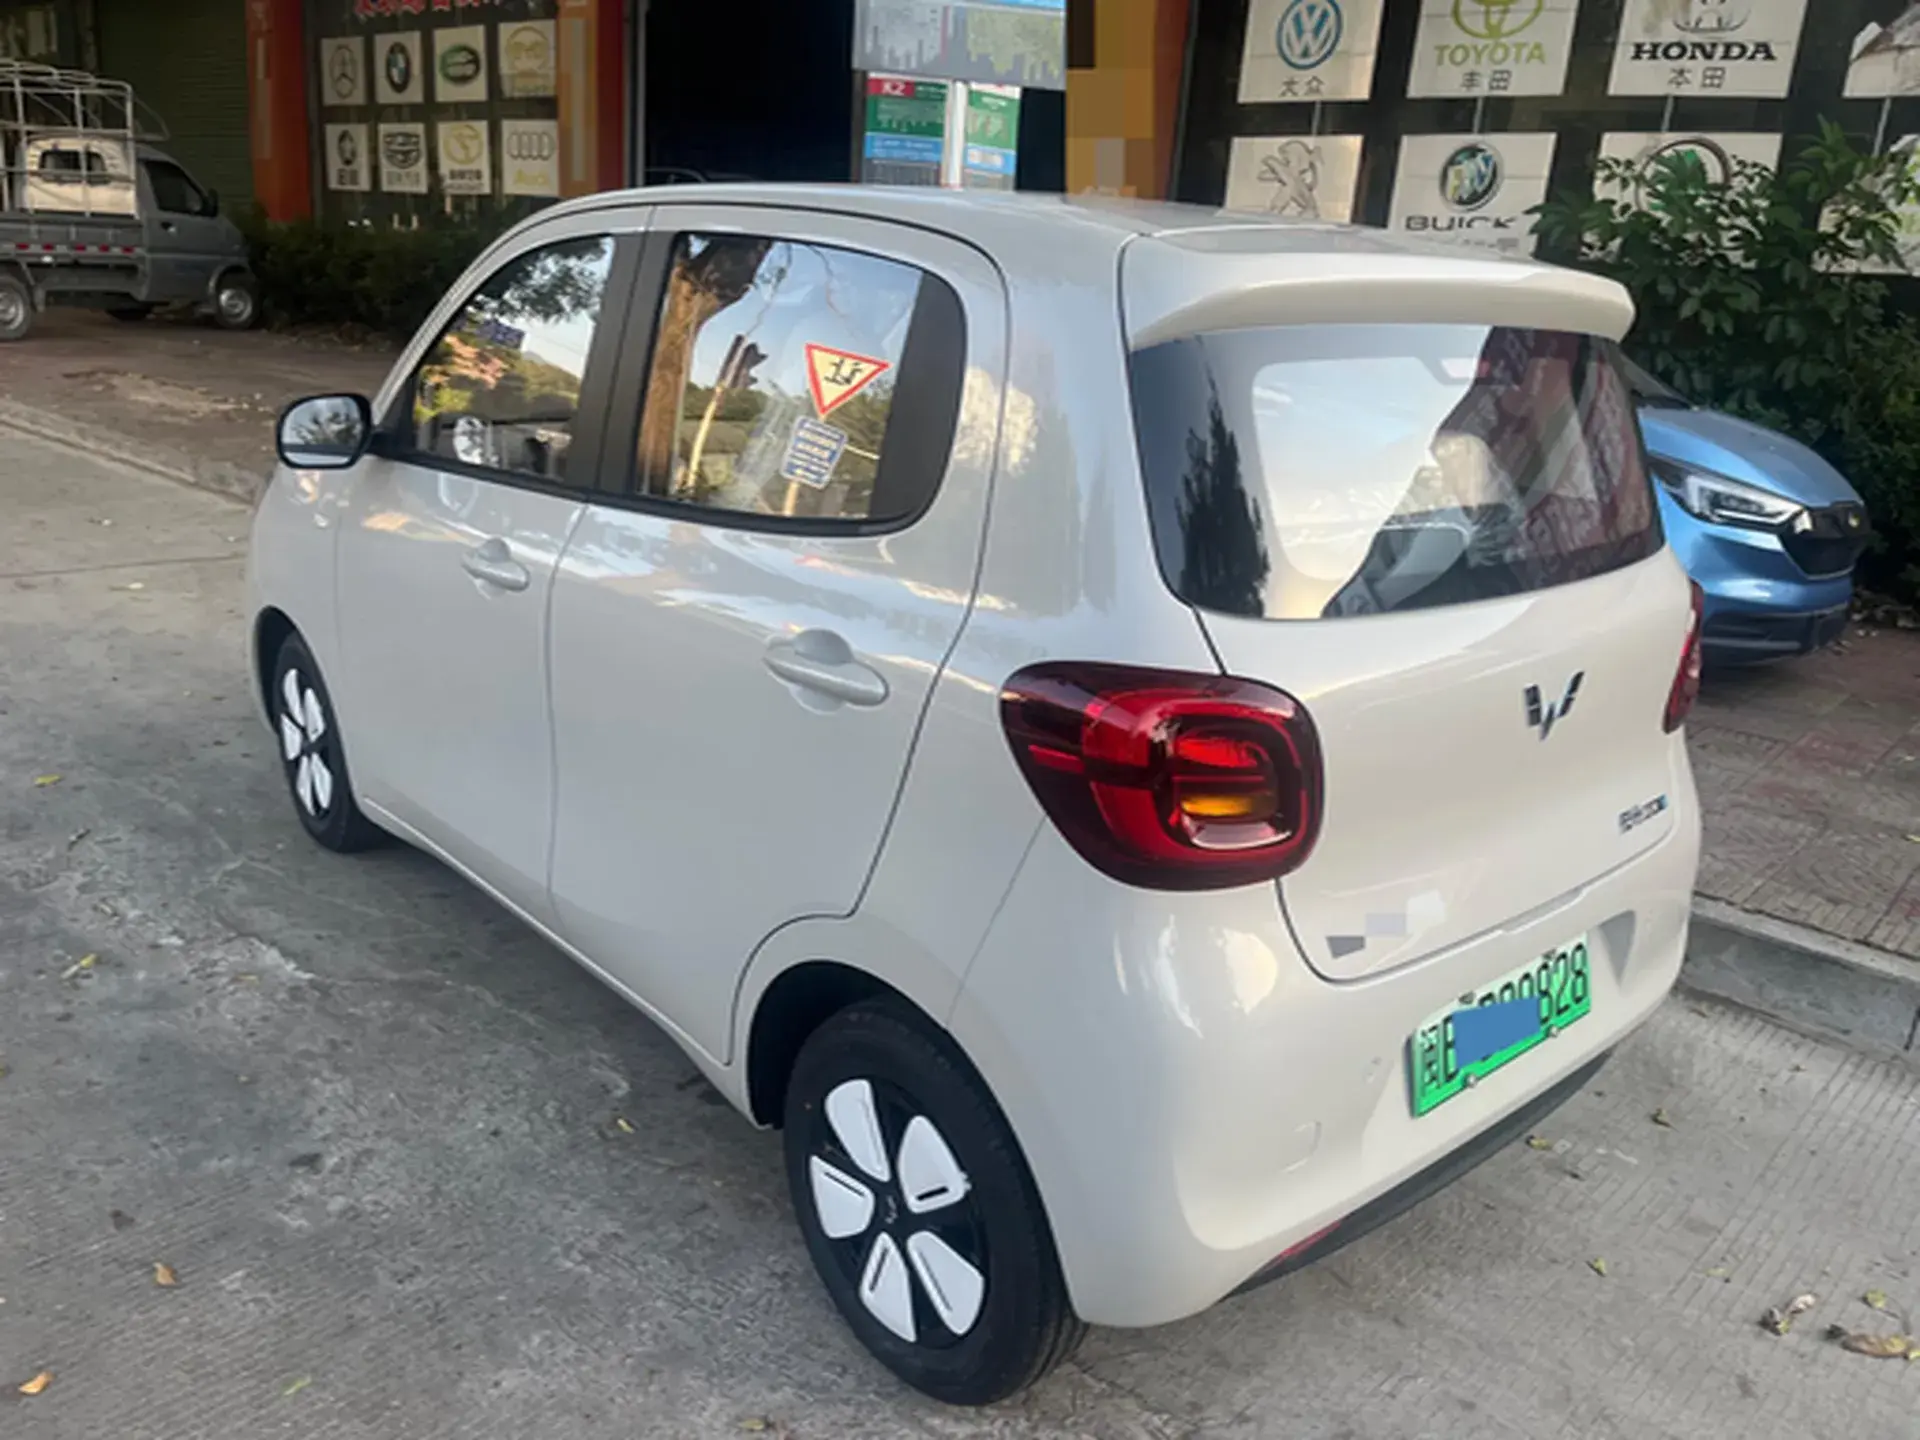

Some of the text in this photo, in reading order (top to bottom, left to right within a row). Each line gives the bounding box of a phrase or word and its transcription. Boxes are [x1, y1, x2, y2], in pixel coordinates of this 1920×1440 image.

[1434, 41, 1546, 67] TOYOTA
[1631, 41, 1777, 61] HONDA
[1280, 75, 1325, 97] 大众
[1460, 70, 1512, 91] 丰田
[1668, 67, 1726, 88] 本田
[1405, 215, 1516, 231] BUICK
